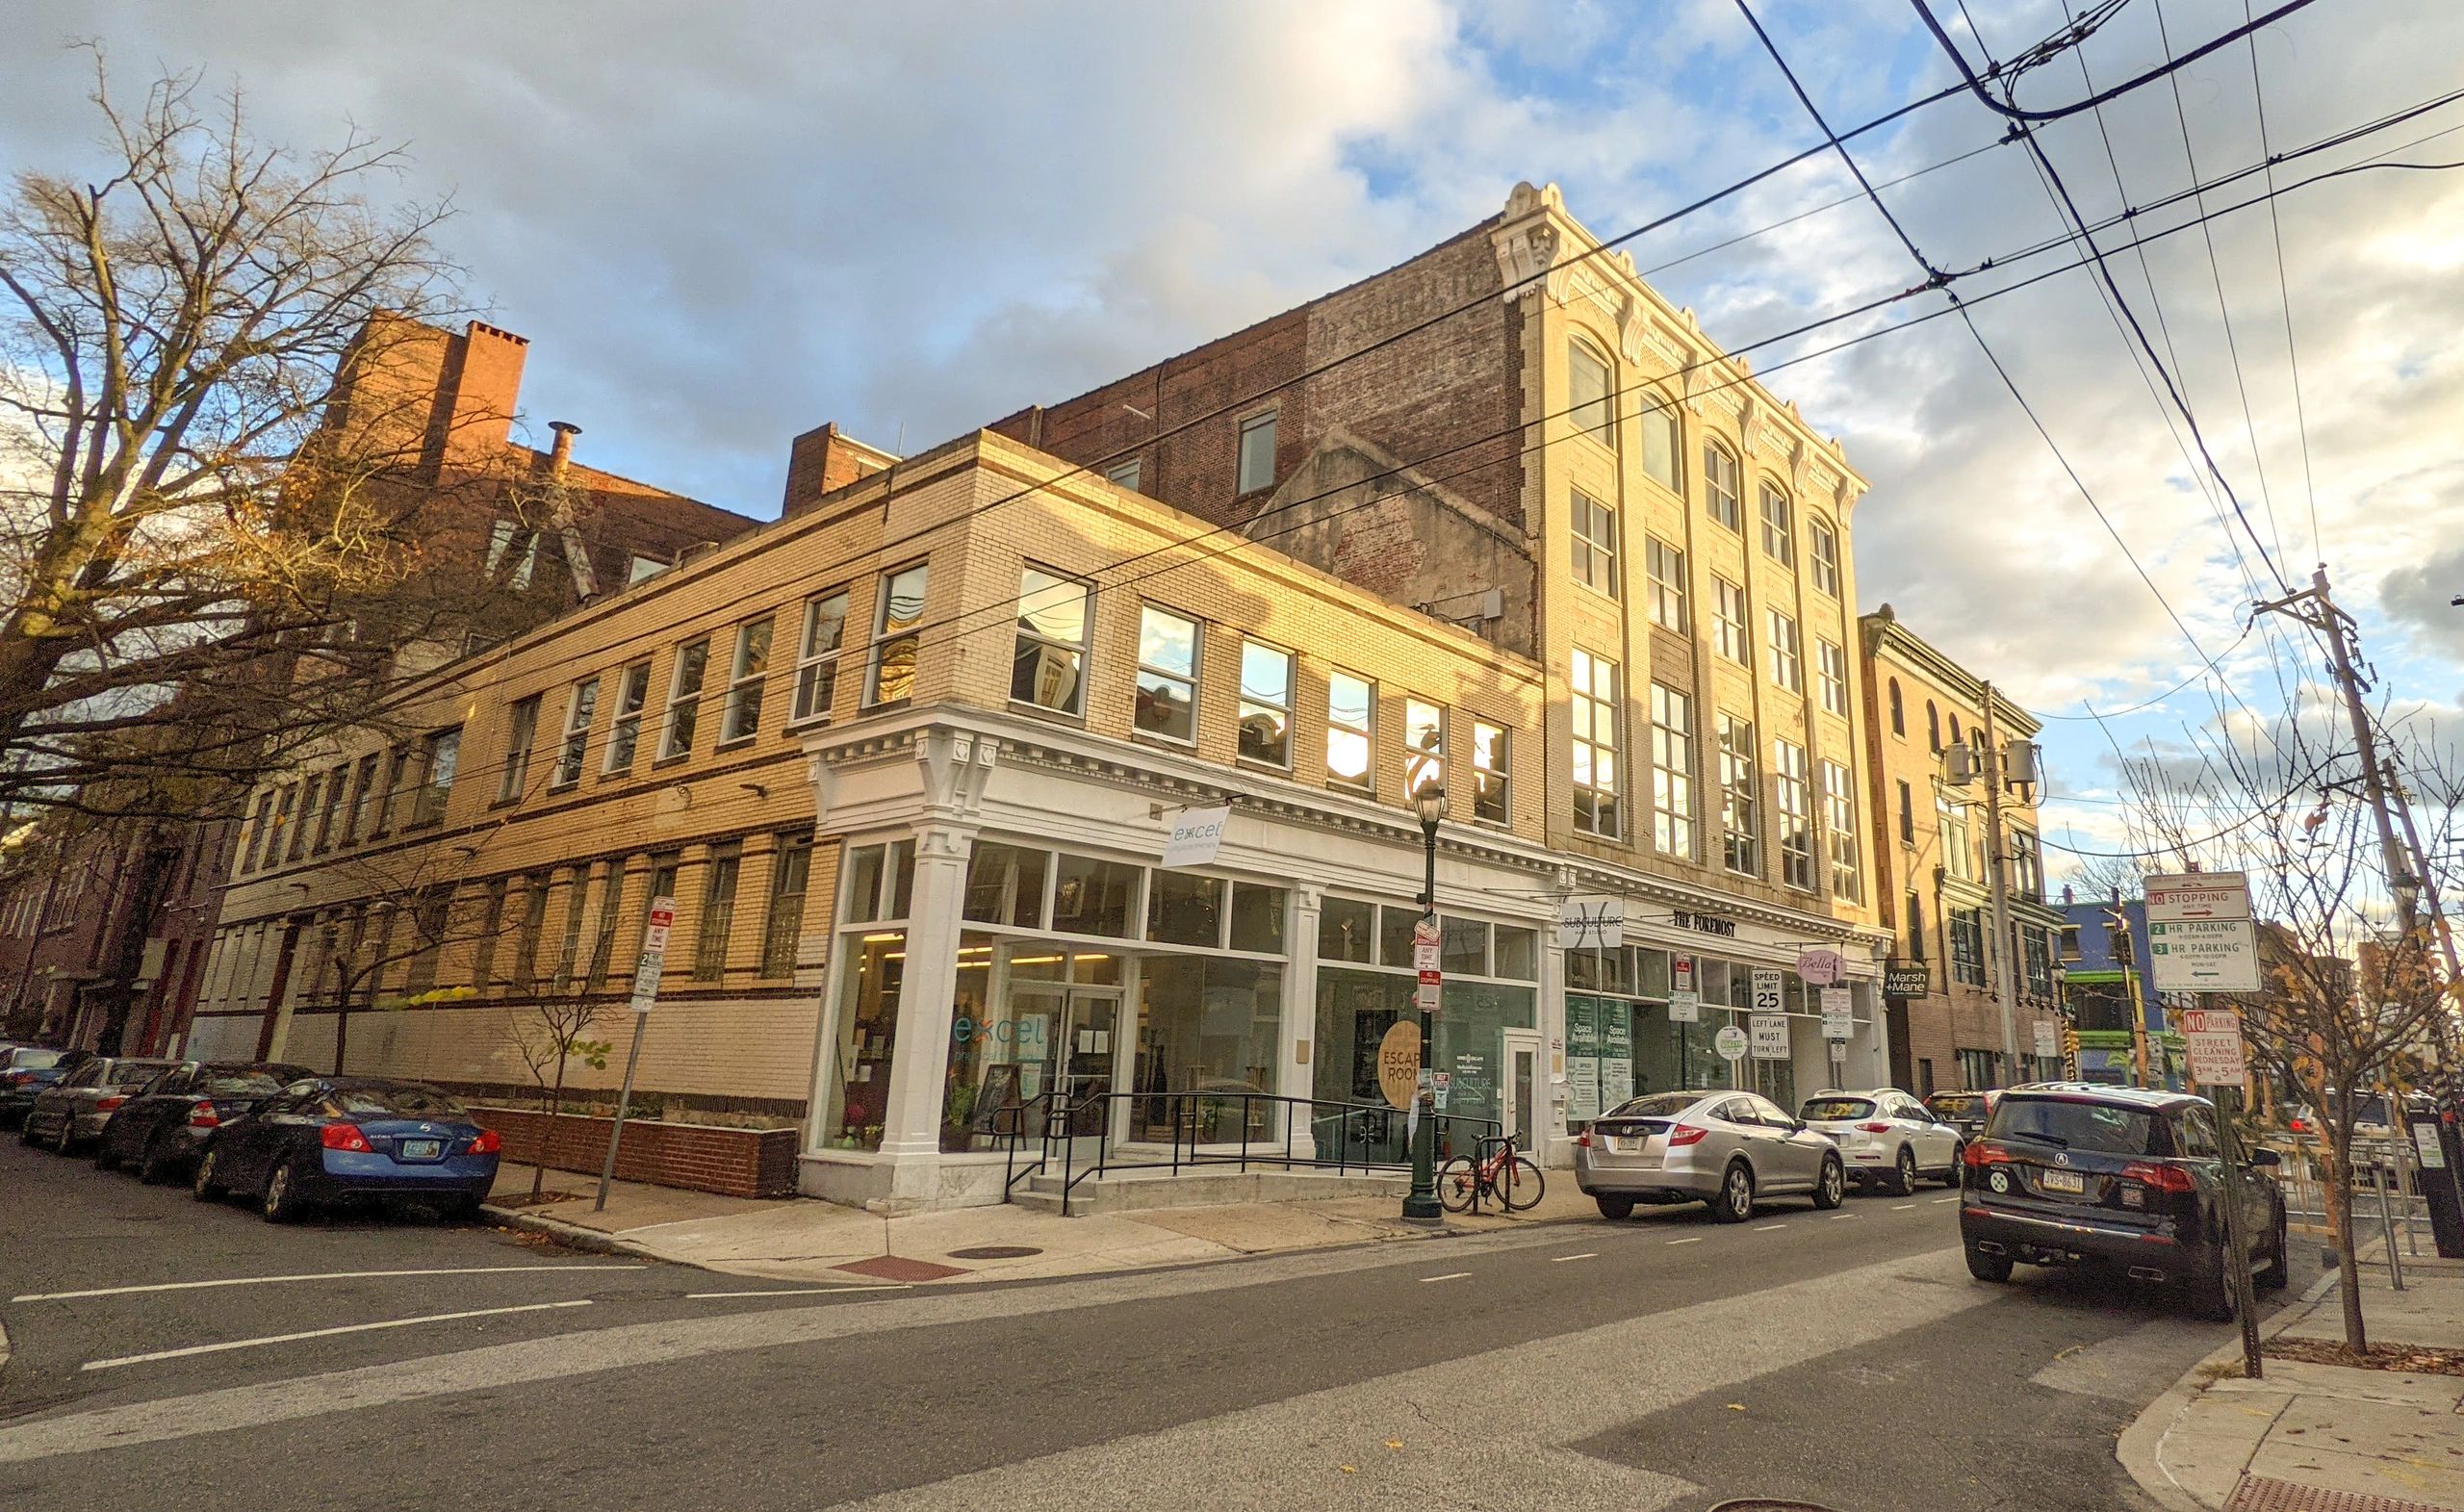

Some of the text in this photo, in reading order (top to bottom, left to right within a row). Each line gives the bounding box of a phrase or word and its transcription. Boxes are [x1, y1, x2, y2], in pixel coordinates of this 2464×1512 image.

[2148, 892, 2229, 904] NO STOPPING
[1563, 915, 1623, 929] SUBCULTURE
[1674, 909, 1735, 937] THE FOREMOST
[2155, 922, 2237, 934] 2 HR PARKING
[2156, 942, 2240, 953] 3 HR PARKING
[641, 954, 648, 965] 2
[1888, 972, 1926, 982] Marsh
[1757, 992, 1779, 1008] 25
[2186, 1014, 2236, 1032] NO PARKING
[1758, 1032, 1780, 1040] MUST
[2194, 1047, 2237, 1056] CLEANING
[1384, 1052, 1421, 1066] ESCAP
[2194, 1056, 2240, 1064] WEDNESDAY
